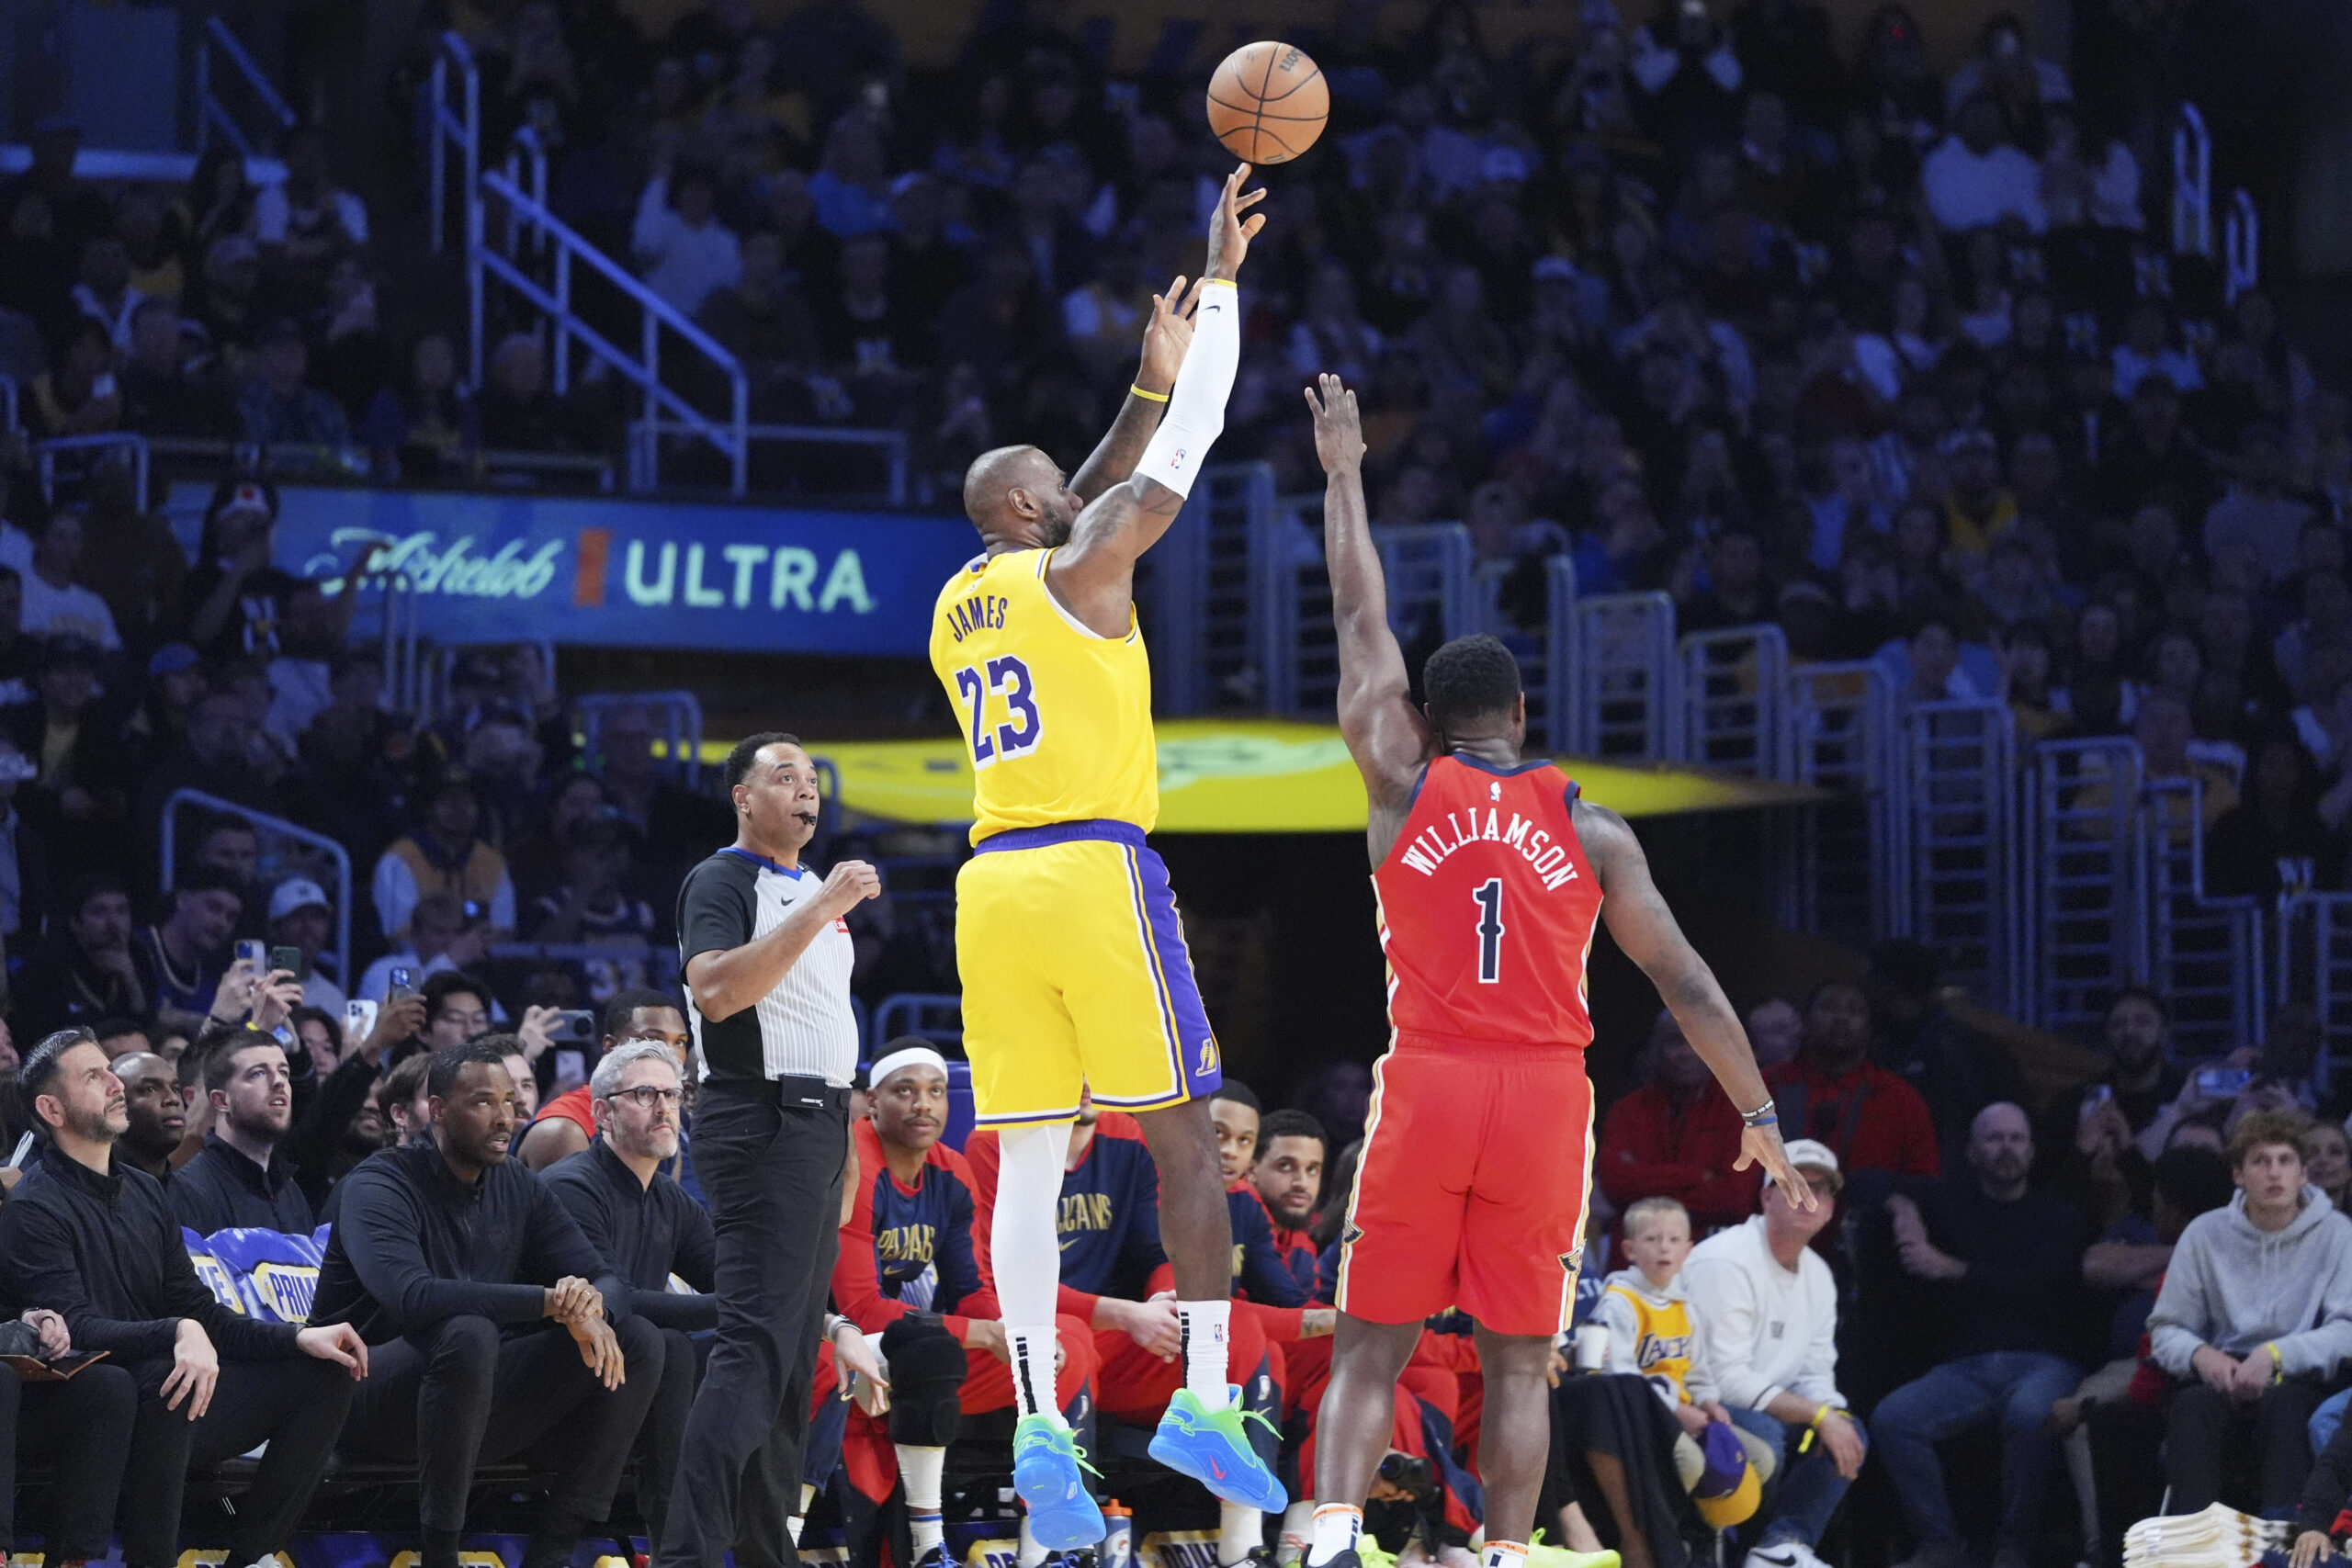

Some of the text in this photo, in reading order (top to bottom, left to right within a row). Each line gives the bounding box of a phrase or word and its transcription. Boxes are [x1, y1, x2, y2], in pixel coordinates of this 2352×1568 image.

[624, 537, 879, 614] ULTRA
[946, 594, 1009, 643] JAMES
[954, 653, 1044, 772] 23
[1401, 807, 1579, 891] WILLIAMSON
[1473, 877, 1506, 984] 1
